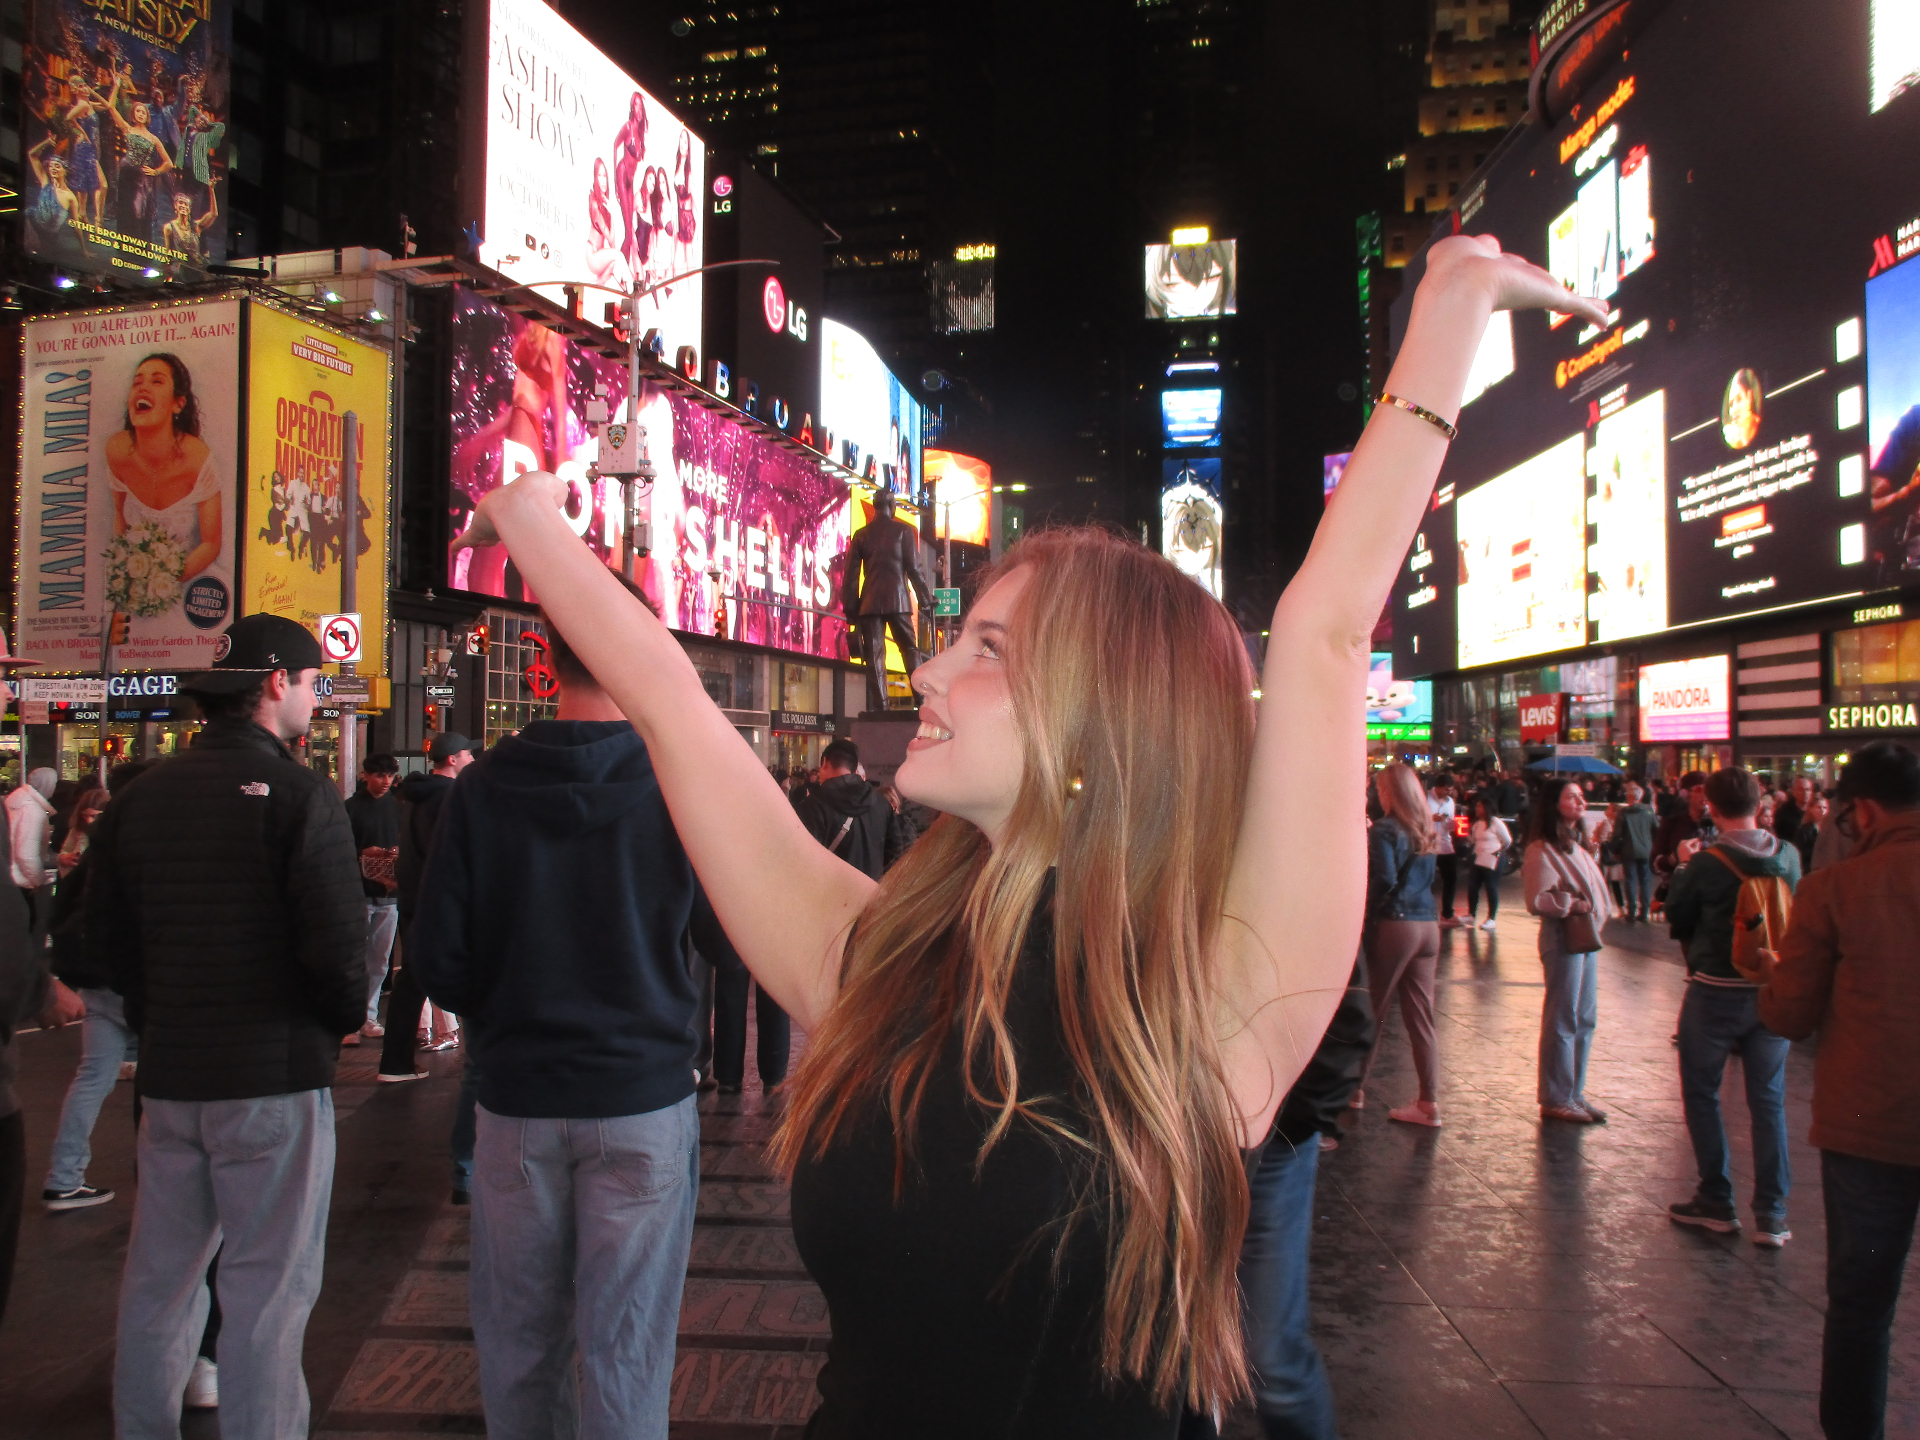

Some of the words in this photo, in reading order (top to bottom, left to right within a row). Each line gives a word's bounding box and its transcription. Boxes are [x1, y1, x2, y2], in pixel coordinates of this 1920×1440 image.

[83, 0, 197, 44] TSBY
[94, 12, 103, 23] A
[105, 15, 130, 33] NEW
[131, 26, 178, 54] MUSICAL
[1540, 0, 1587, 52] MARQUIS
[501, 83, 582, 167] SHOW
[714, 202, 731, 214] LG
[76, 221, 95, 233] THE
[97, 227, 148, 249] BROADWAY
[149, 242, 189, 262] THEATRE
[88, 234, 112, 247] 53RD
[122, 243, 171, 264] BROADWAY
[72, 321, 97, 335] YOU
[101, 314, 156, 332] ALREADY
[160, 310, 198, 326] KNOW
[788, 300, 807, 341] LG
[36, 338, 78, 354] YOU'RE
[82, 333, 126, 350] GONNA
[130, 328, 161, 345] LOVE
[165, 328, 187, 342] IT...
[191, 322, 235, 339] AGAIN!
[306, 336, 323, 350] LITTLE
[293, 343, 313, 359] VERY
[313, 351, 326, 365] BIG
[326, 356, 352, 375] FUTURE
[44, 369, 91, 456] MIA!
[276, 396, 364, 461] OPERATIN
[679, 458, 729, 503] MORE
[38, 463, 88, 612] MAMMA
[191, 587, 225, 600] STRICTLY
[192, 597, 221, 609] LIMITED
[186, 604, 226, 619] ENGAGEMENT
[1854, 604, 1902, 623] SEPHORA
[26, 638, 50, 650] BACK
[51, 637, 65, 649] ON
[132, 635, 160, 647] Winter
[162, 632, 194, 647] Garden
[35, 682, 70, 691] PEDESTRIAN
[73, 682, 89, 691] FLOW
[89, 683, 105, 692] ZONE
[51, 691, 73, 699] MOVING
[1652, 687, 1711, 710] PANDORA
[791, 714, 804, 725] POLO
[1521, 706, 1557, 727] Levi's
[1828, 703, 1918, 730] SEPHORA
